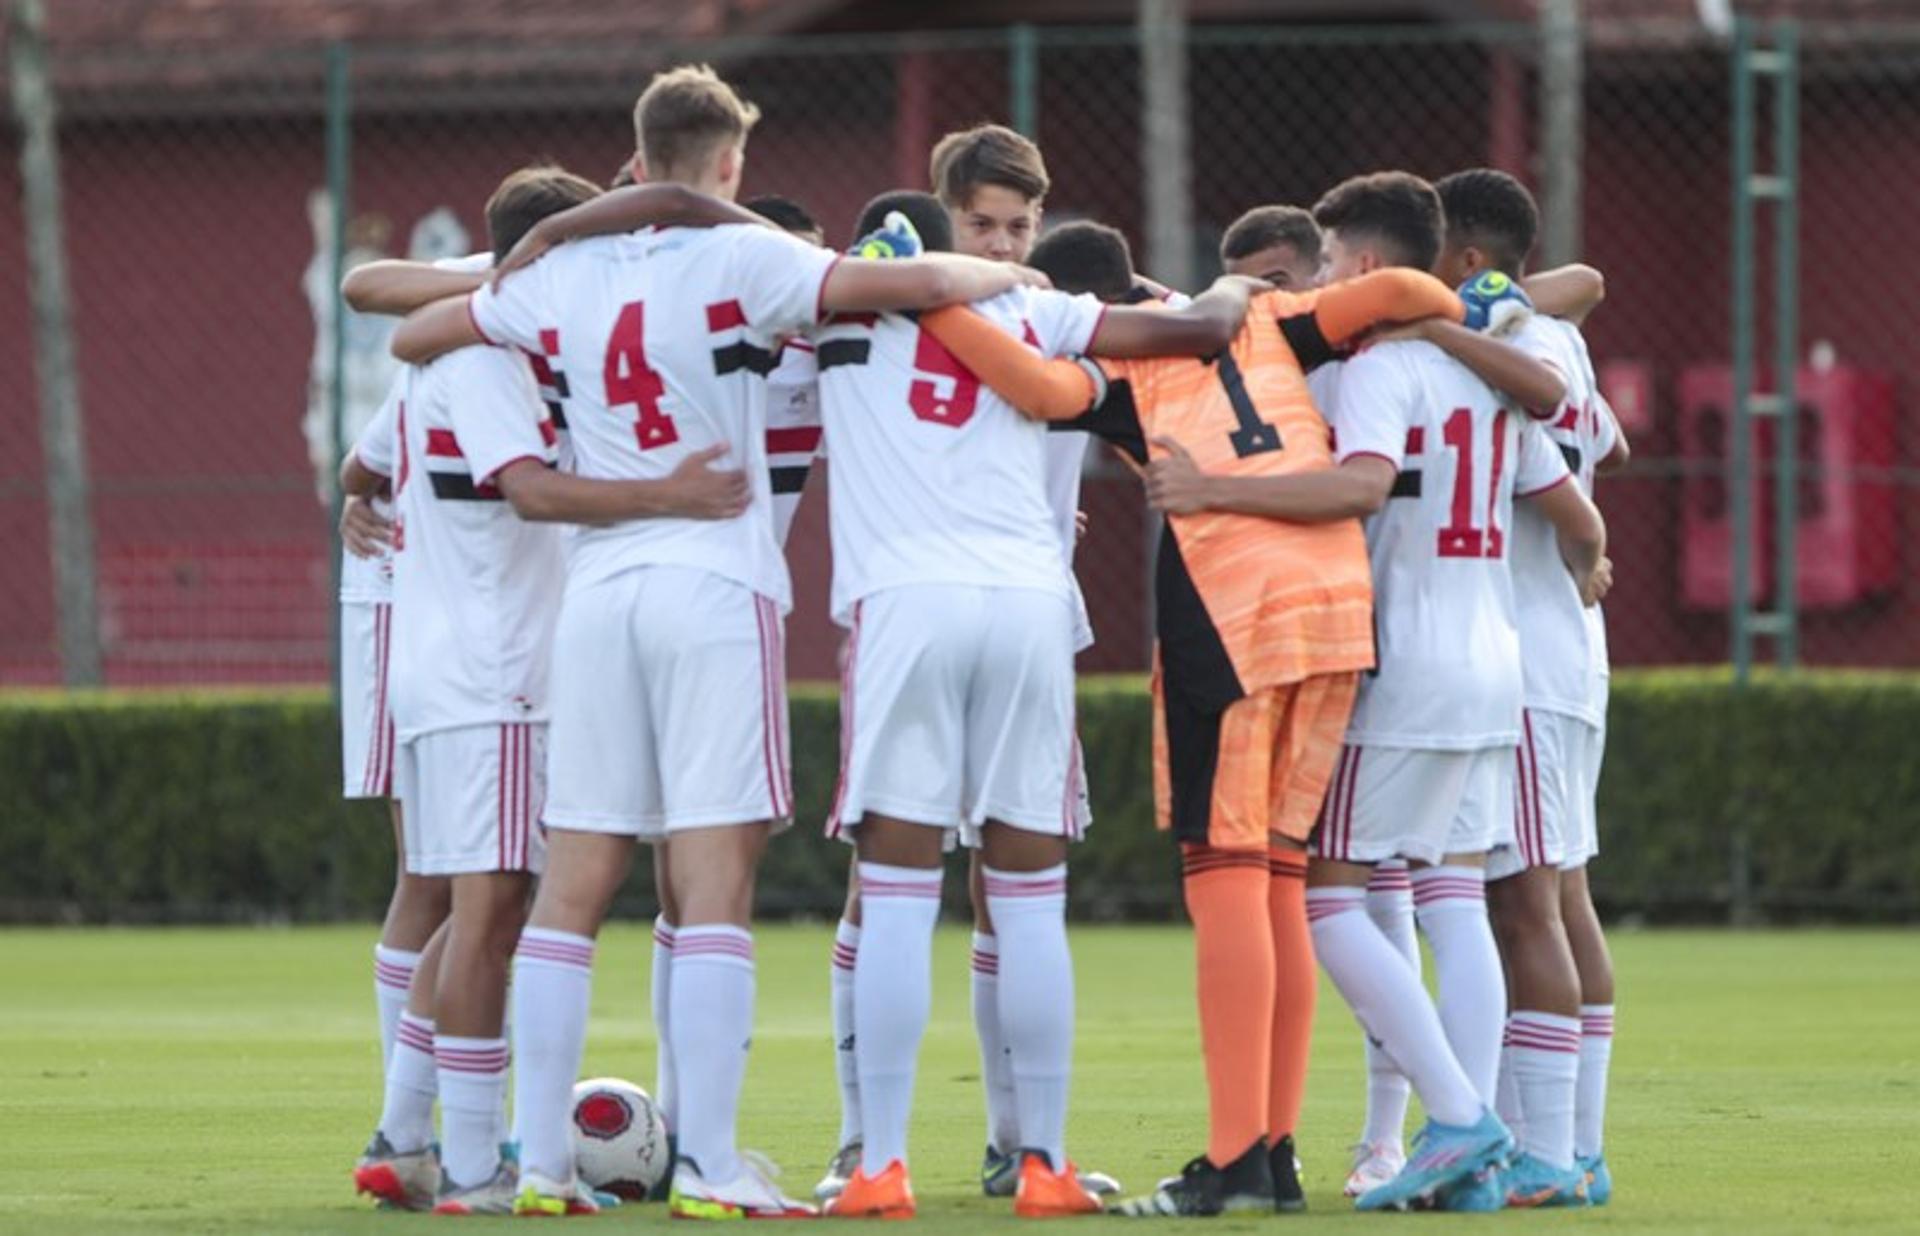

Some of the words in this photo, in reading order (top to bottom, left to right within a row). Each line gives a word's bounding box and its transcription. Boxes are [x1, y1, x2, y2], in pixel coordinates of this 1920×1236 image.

[604, 300, 678, 451] 4
[909, 326, 979, 428] 5
[1218, 345, 1284, 459] 1
[1438, 408, 1503, 558] 11
